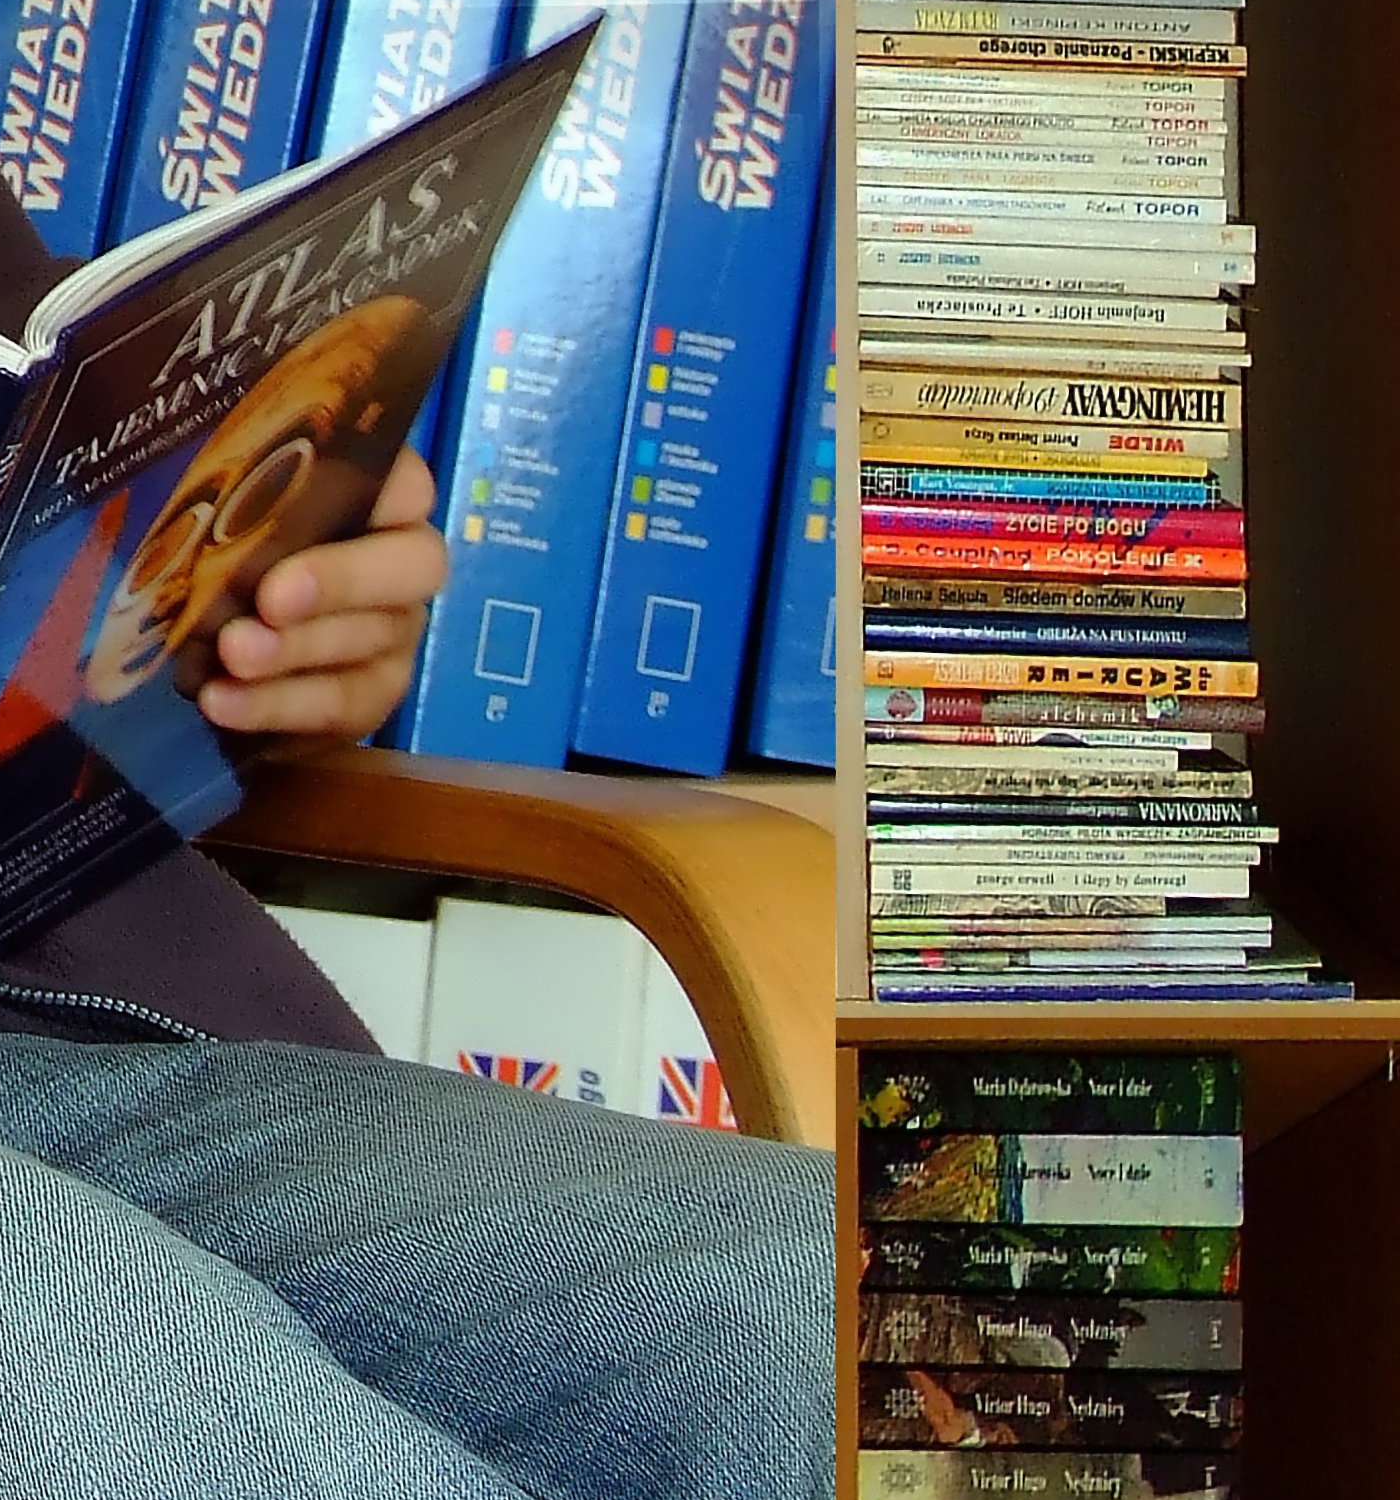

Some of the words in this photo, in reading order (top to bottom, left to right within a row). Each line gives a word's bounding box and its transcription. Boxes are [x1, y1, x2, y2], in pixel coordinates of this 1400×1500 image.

[979, 41, 1046, 56] chorego
[1054, 42, 1132, 62] Poznanie
[1149, 45, 1229, 64] KĘPIŃSKI
[150, 153, 459, 389] ATLAS
[1062, 383, 1225, 424] HEMINGWAY
[1108, 434, 1184, 453] WILDE
[1006, 515, 1059, 533] ŻYCIE
[1064, 519, 1090, 535] PO
[1095, 519, 1146, 536] BOGU
[1004, 588, 1068, 607] Siedem
[1073, 590, 1135, 608] domów
[1140, 592, 1185, 612] Kuny
[1028, 666, 1192, 691] MAURIER
[1139, 803, 1242, 821] NARKOMANIA
